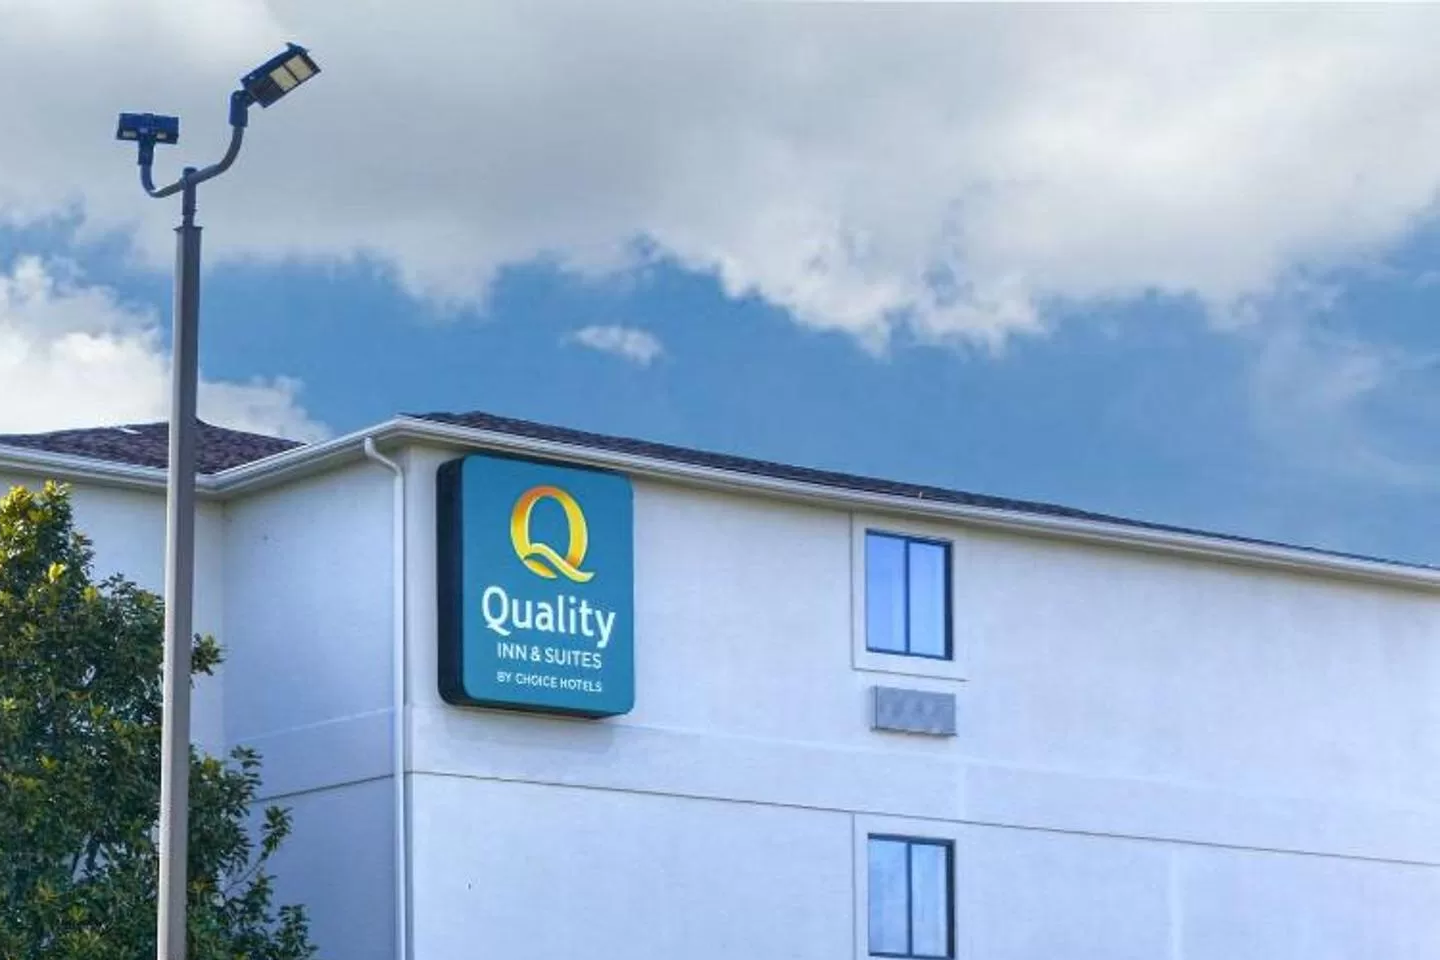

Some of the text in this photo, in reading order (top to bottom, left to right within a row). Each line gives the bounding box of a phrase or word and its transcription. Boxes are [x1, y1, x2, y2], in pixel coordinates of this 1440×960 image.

[511, 485, 595, 583] Q
[481, 586, 616, 649] Quality
[496, 641, 603, 669] INN & SUITES
[496, 671, 603, 693] BY CHOICE HOTELS
